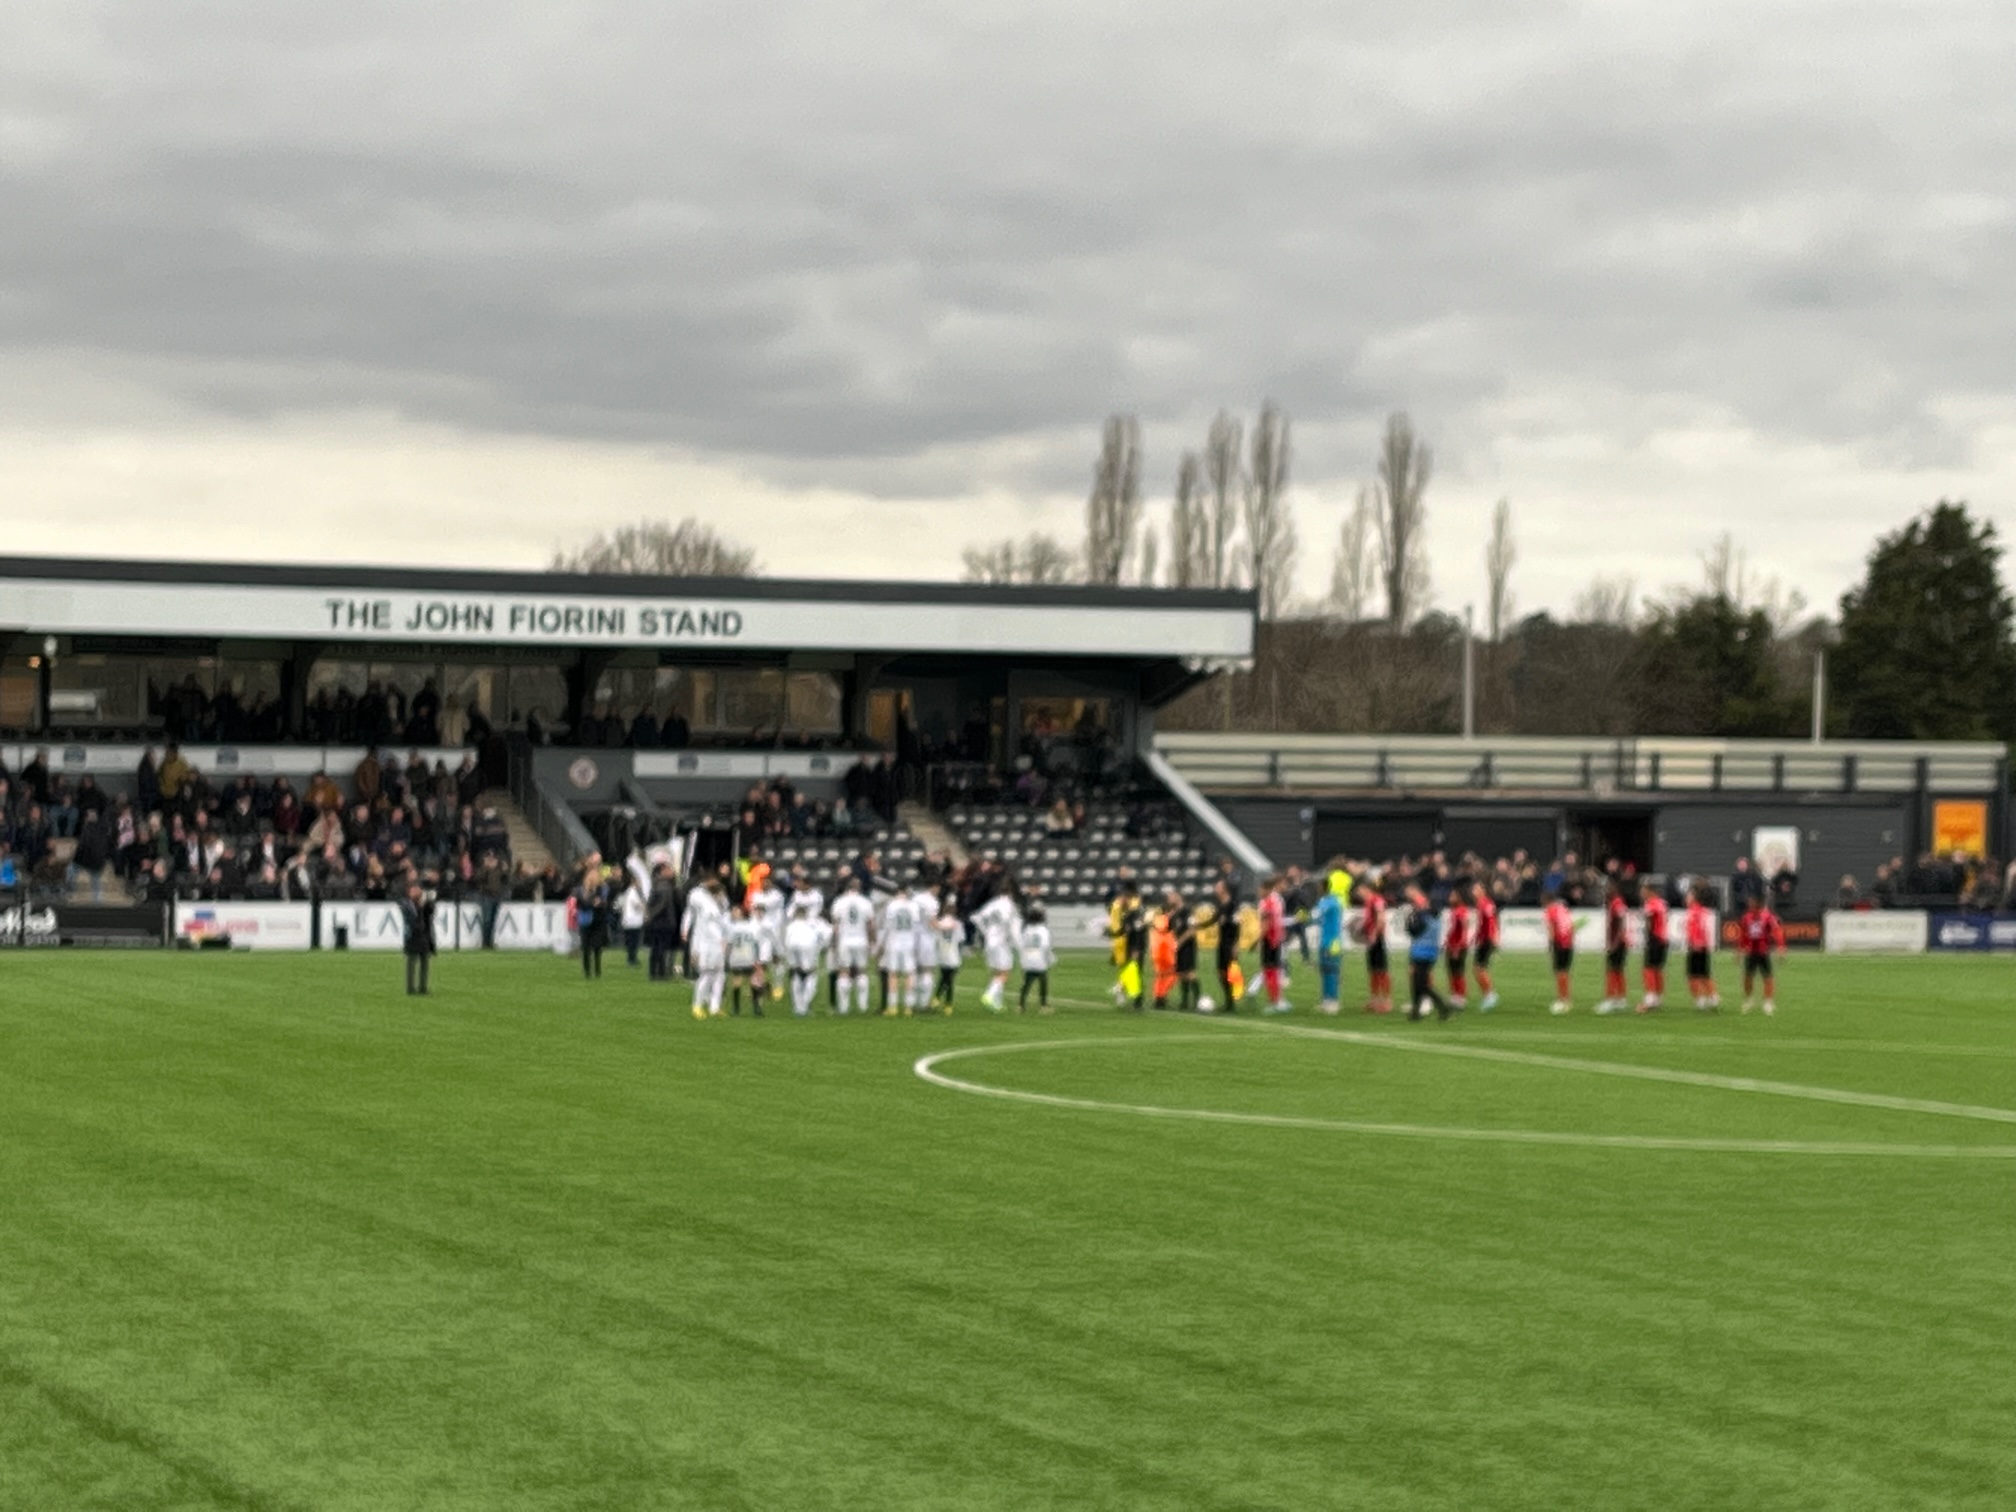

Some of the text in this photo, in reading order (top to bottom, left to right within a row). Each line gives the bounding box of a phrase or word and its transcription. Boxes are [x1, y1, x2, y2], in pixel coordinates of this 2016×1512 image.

[325, 598, 742, 637] THE JOHN FIORINI STAND
